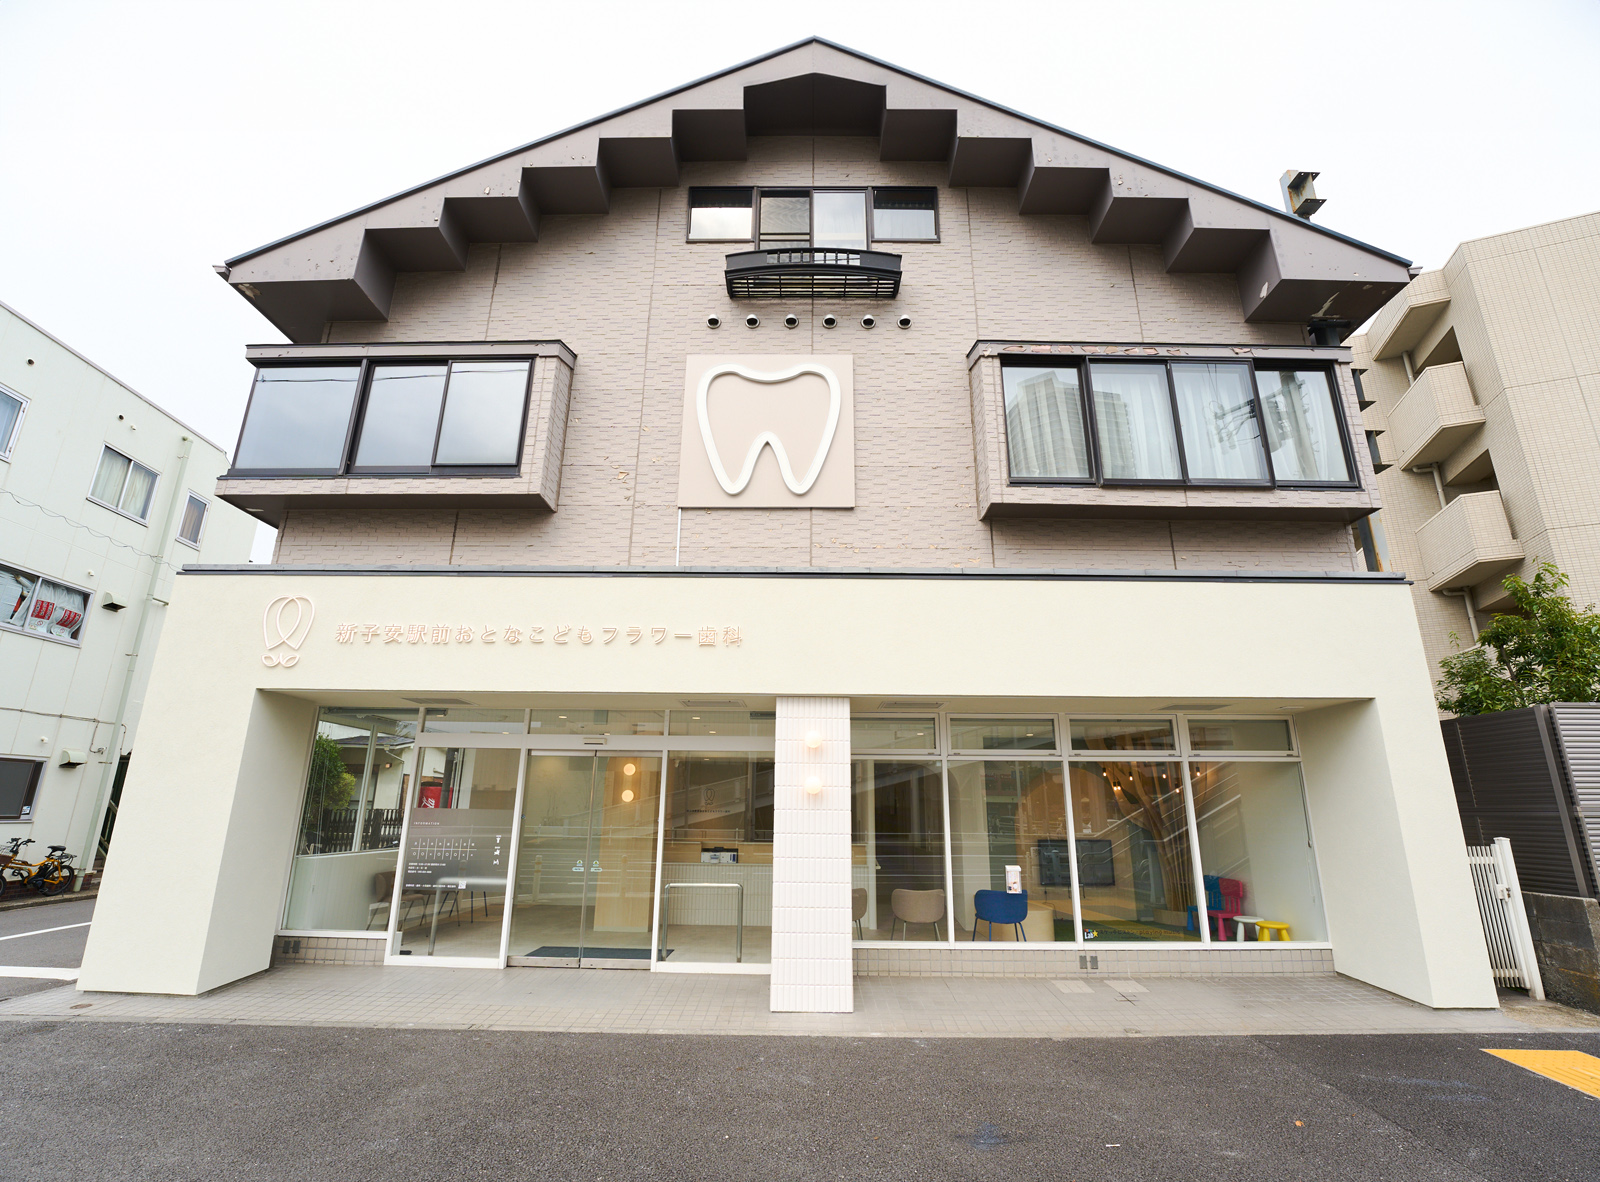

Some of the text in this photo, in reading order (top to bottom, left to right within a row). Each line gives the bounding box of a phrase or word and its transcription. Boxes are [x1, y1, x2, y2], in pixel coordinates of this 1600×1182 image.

[335, 622, 742, 647] 新子安駅前おとなこどもフラワー歯科
